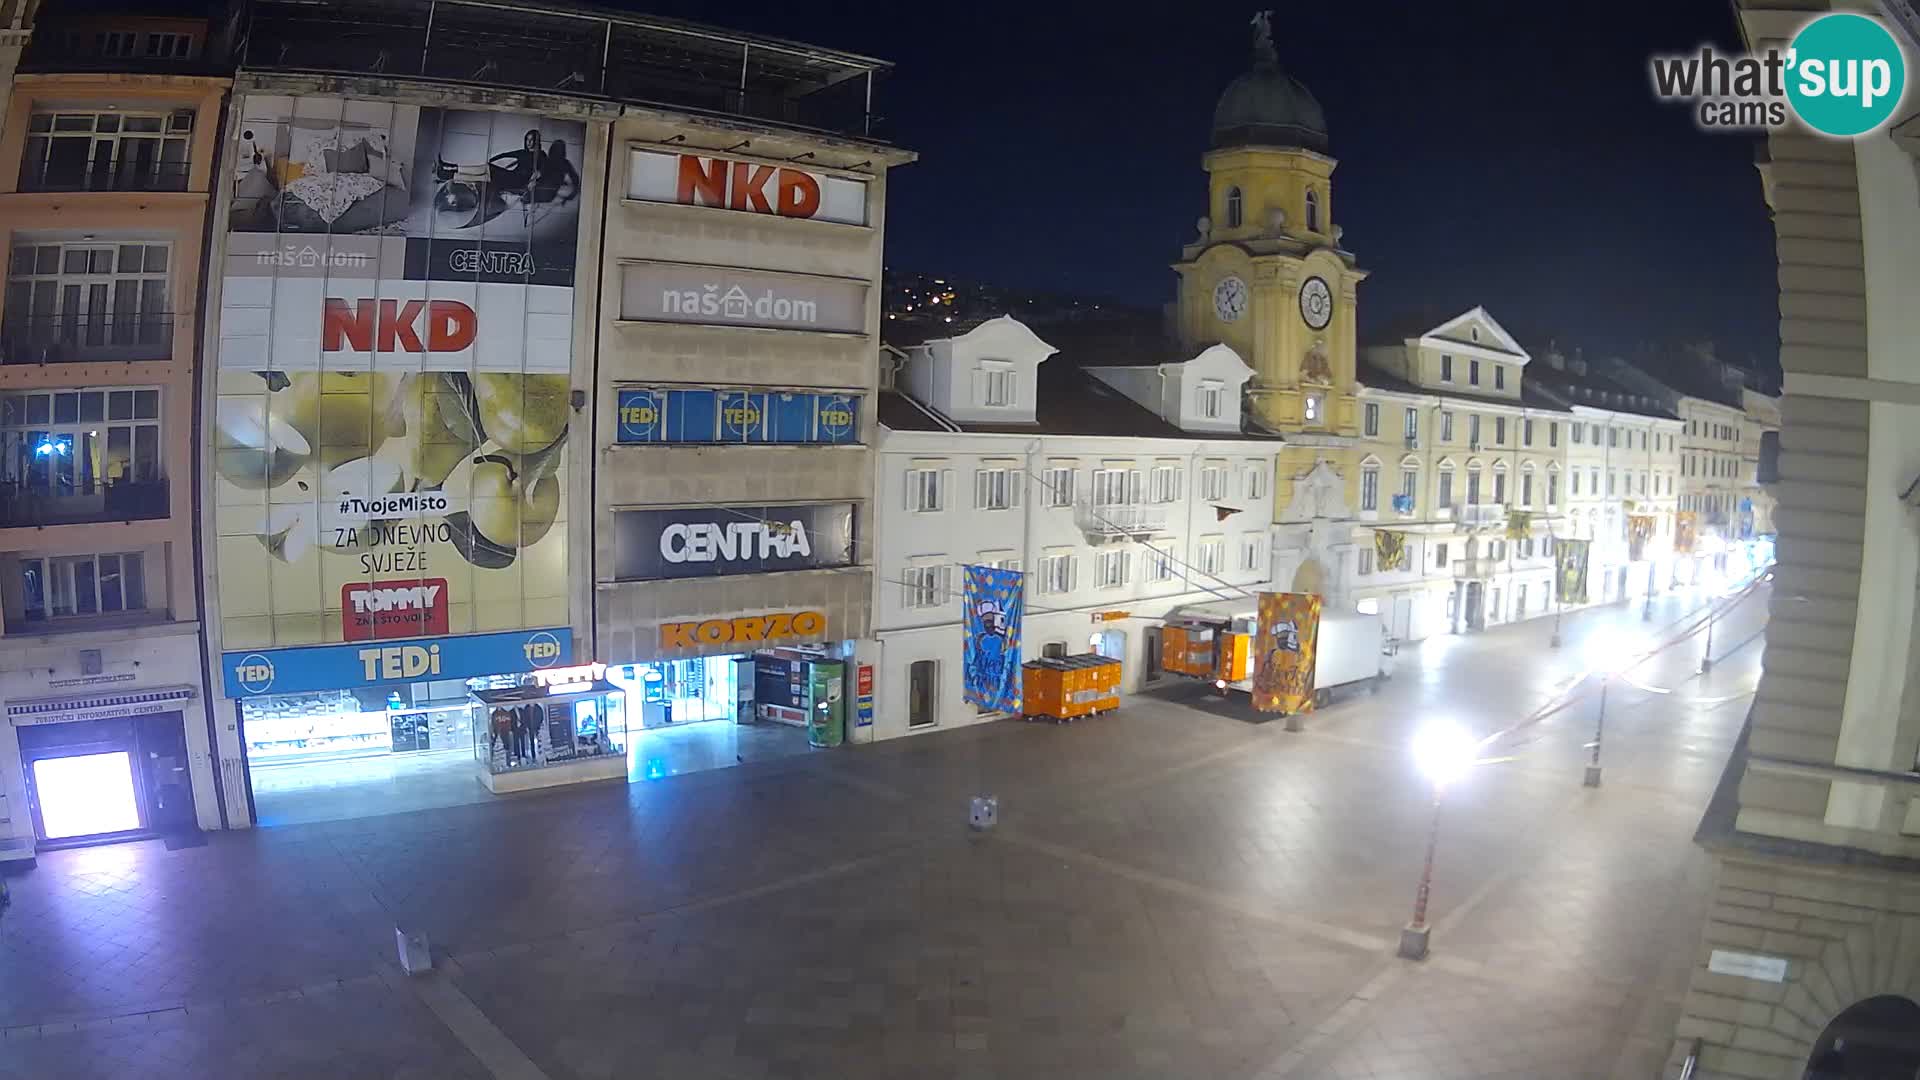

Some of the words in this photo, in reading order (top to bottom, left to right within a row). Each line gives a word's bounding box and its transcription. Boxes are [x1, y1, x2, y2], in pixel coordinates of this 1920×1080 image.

[677, 155, 820, 219] NKD
[321, 247, 367, 268] dom
[449, 249, 535, 275] CENTRA
[662, 284, 719, 315] naš
[754, 289, 816, 322] dom
[322, 298, 478, 352] NKD
[619, 407, 658, 424] TEDi
[724, 408, 760, 425] TEDi
[820, 410, 853, 426] TEDi
[340, 496, 447, 515] #TvojeMisto
[335, 528, 358, 547] ZA
[368, 523, 451, 547] DNEVNO
[660, 520, 810, 563] CENTRA
[360, 546, 427, 574] SVJEŽE
[350, 585, 440, 613] TOMMY
[660, 611, 826, 648] KORZO
[359, 644, 441, 681] TEDi
[523, 642, 561, 659] TEDi
[235, 664, 275, 681] TEDi
